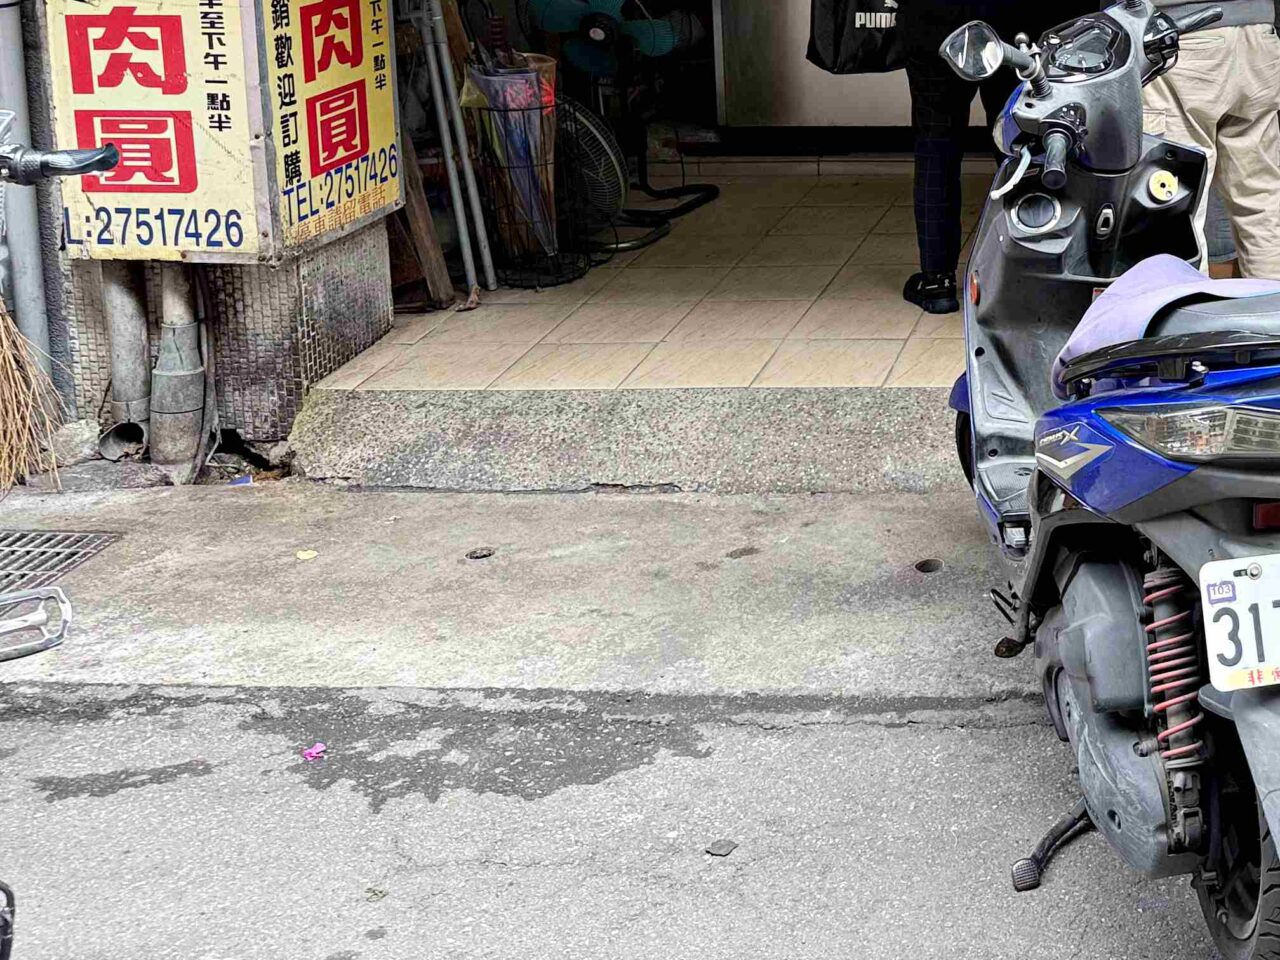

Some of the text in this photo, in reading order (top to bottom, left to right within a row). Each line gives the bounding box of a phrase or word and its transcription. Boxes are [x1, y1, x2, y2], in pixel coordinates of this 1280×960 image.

[855, 12, 896, 28] PUMA
[282, 143, 399, 227] TEL:27517426
[1211, 585, 1232, 596] 103
